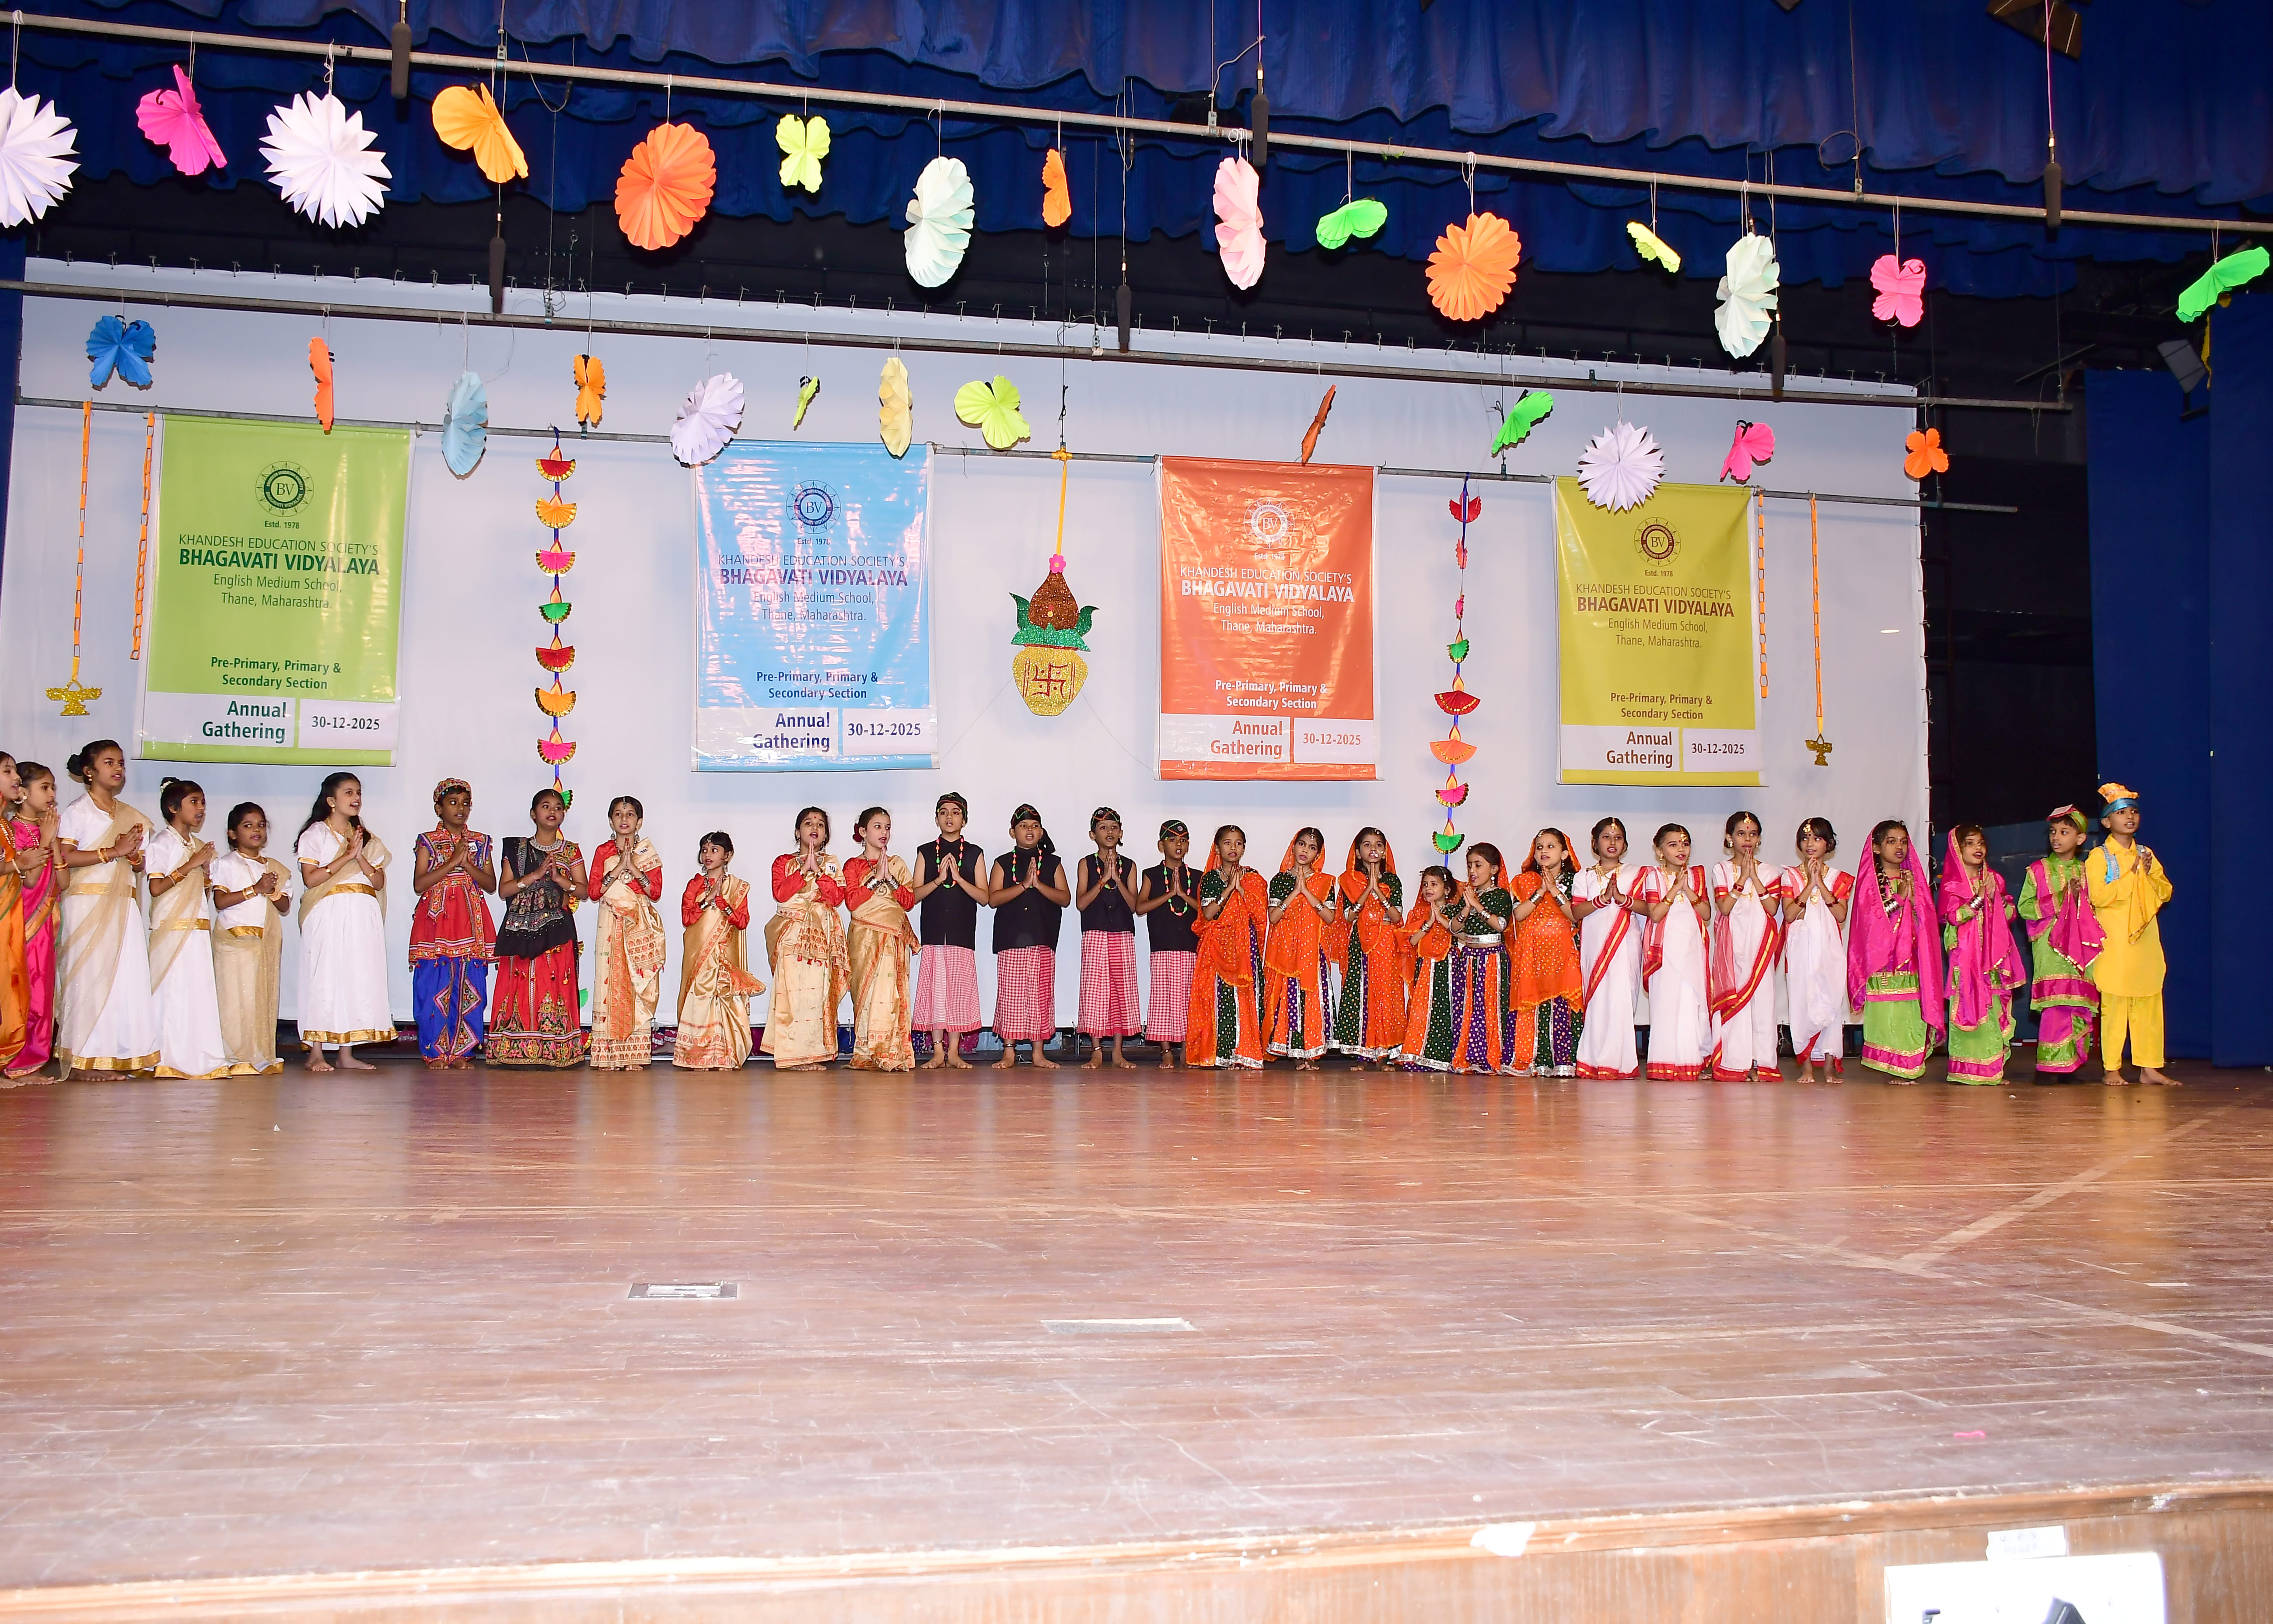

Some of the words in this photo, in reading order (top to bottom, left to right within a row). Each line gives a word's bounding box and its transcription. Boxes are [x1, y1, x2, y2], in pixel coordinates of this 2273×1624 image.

[179, 535, 243, 547] KHANDESH
[248, 538, 316, 551] EDUCATION
[320, 542, 378, 555] SOCIETY'S
[180, 549, 277, 569] BHAGAVATI
[285, 555, 379, 575] VIDYALAYA
[717, 555, 778, 565] KHANDESH
[783, 555, 846, 566] EDUCATION
[851, 556, 905, 566] SOCIETY'S
[213, 574, 252, 589] English
[256, 577, 300, 589] Medium
[304, 578, 343, 592] School,
[720, 569, 812, 585] BHAGAVATI
[818, 570, 907, 586] VIDYALAYA
[1181, 567, 1237, 578] KHANDESH
[1241, 569, 1300, 581] EDUCATION
[1304, 571, 1352, 584] SOCIETY'S
[754, 592, 790, 604] English
[794, 592, 835, 603] Medium
[838, 592, 874, 605] School,
[1182, 581, 1268, 598] BHAGAVATI
[1274, 584, 1354, 602] VIDYALAYA
[1576, 584, 1630, 595] KHANDESH
[1633, 585, 1687, 597] EDUCATION
[1690, 588, 1731, 599] SOCIETY'S
[222, 593, 257, 606] Thane,
[262, 595, 332, 609] Maharashtra.
[1577, 597, 1658, 613] BHAGAVATI
[1663, 599, 1734, 617] VIDYALAYA
[762, 609, 796, 621] Thane,
[800, 609, 866, 621] Maharashtra.
[1214, 603, 1247, 617] English
[1251, 604, 1289, 616] Medium
[1292, 606, 1325, 620] School,
[1221, 620, 1253, 633] Thane,
[1256, 622, 1317, 635] Maharashtra.
[1609, 618, 1640, 630] English
[1643, 620, 1678, 630] Medium
[1680, 621, 1707, 634] School,
[1616, 635, 1645, 647] Thane,
[1648, 636, 1701, 648] Maharashtra.
[211, 658, 280, 672] Pre-Primary,
[284, 660, 329, 675] Primary
[333, 663, 341, 673] &
[222, 675, 282, 690] Secondary
[286, 677, 327, 689] Section
[756, 671, 822, 684] Pre-Primary,
[826, 672, 868, 684] Primary
[871, 672, 878, 682] &
[768, 688, 825, 700] Secondary
[828, 688, 867, 699] Section
[1215, 680, 1276, 693] Pre-Primary,
[1280, 682, 1318, 695] Primary
[1320, 684, 1328, 693] &
[1226, 696, 1278, 710] Secondary
[1281, 698, 1317, 709] Section
[1610, 693, 1666, 705] Pre-Primary,
[1669, 694, 1703, 706] Primary
[1706, 695, 1712, 704] &
[227, 701, 287, 718] Annual
[1621, 708, 1668, 720] Secondary
[1672, 710, 1703, 720] Section
[311, 716, 380, 730] 30-12-2025
[775, 713, 830, 728] Annual
[202, 721, 285, 743] Gathering
[847, 723, 921, 736] 30-12-2025
[1232, 721, 1283, 736] Annual
[753, 733, 830, 752] Gathering
[1303, 733, 1361, 745] 30-12-2025
[1626, 732, 1672, 746] Annual
[1210, 740, 1282, 759] Gathering
[1692, 743, 1745, 755] 30-12-2025
[1607, 750, 1673, 767] Gathering
